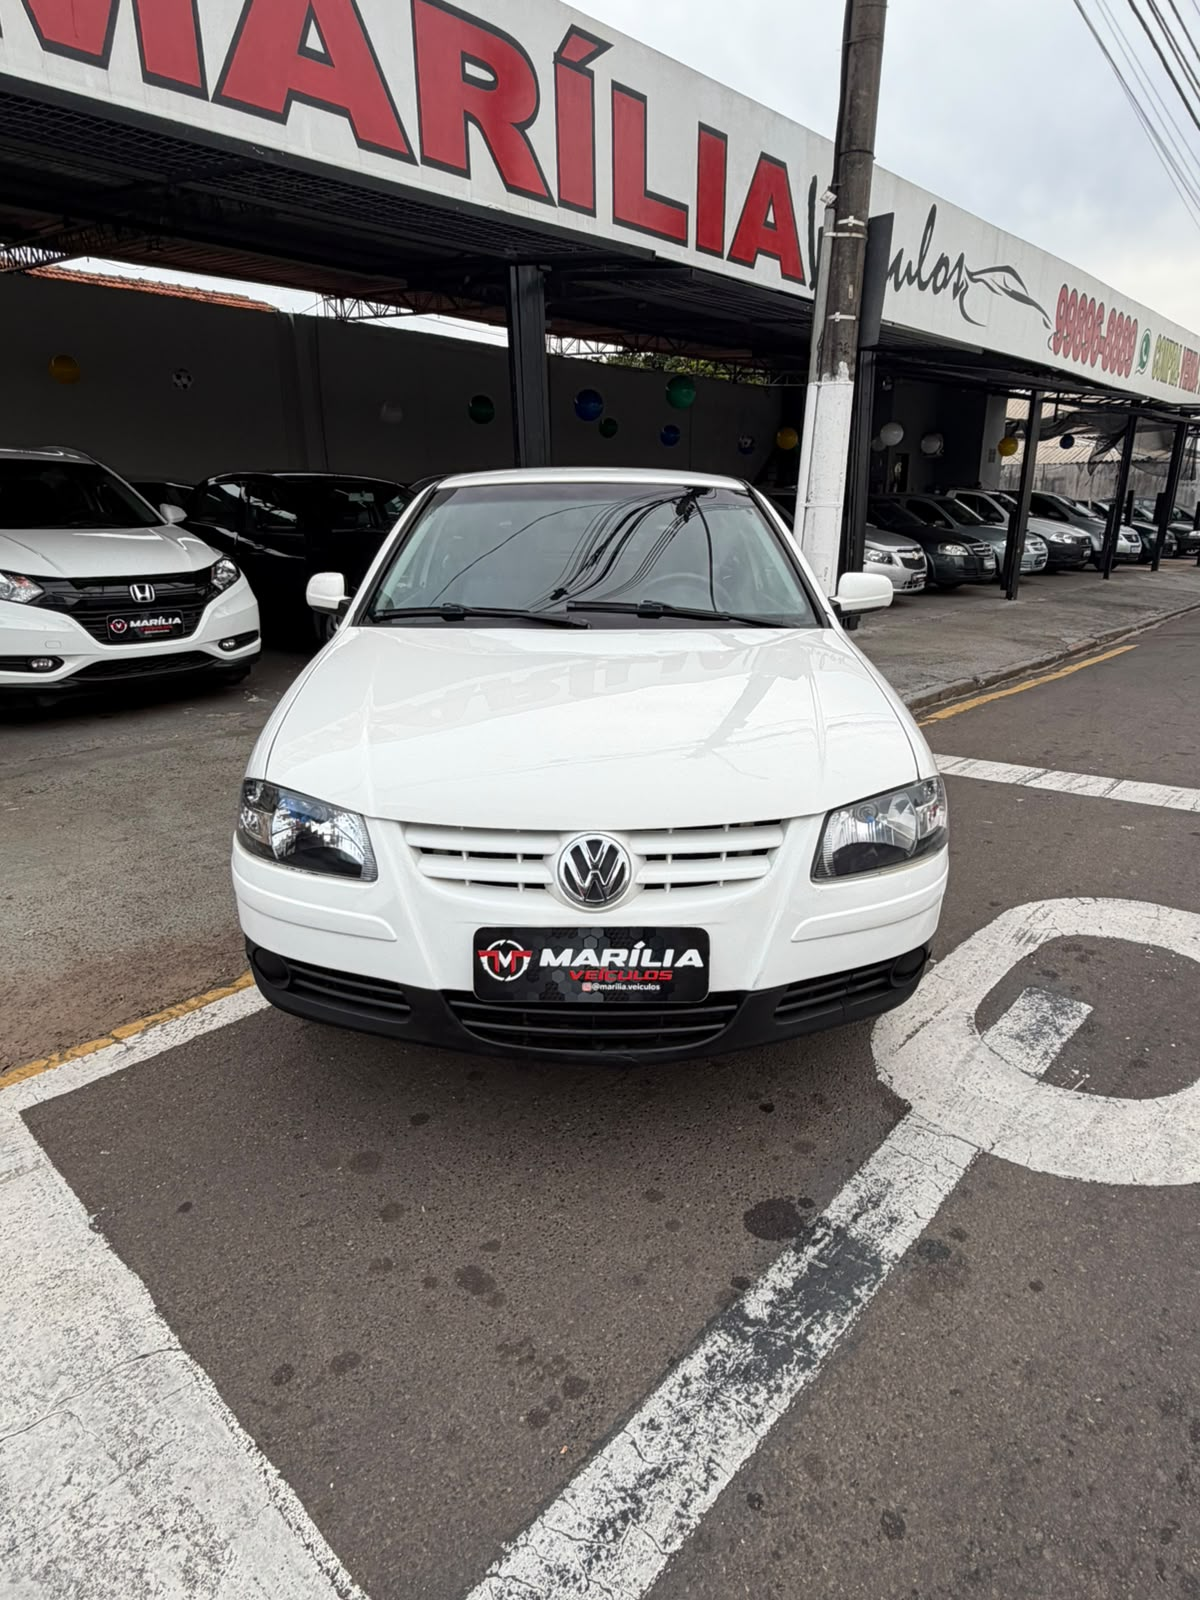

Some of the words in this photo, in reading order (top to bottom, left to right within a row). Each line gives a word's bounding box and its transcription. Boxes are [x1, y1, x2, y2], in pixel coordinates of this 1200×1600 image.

[1052, 283, 1138, 379] 99896-8889
[129, 616, 182, 628] MARÍLIA
[539, 940, 704, 968] MARÍLIA
[568, 967, 673, 982] VEÍCULOS
